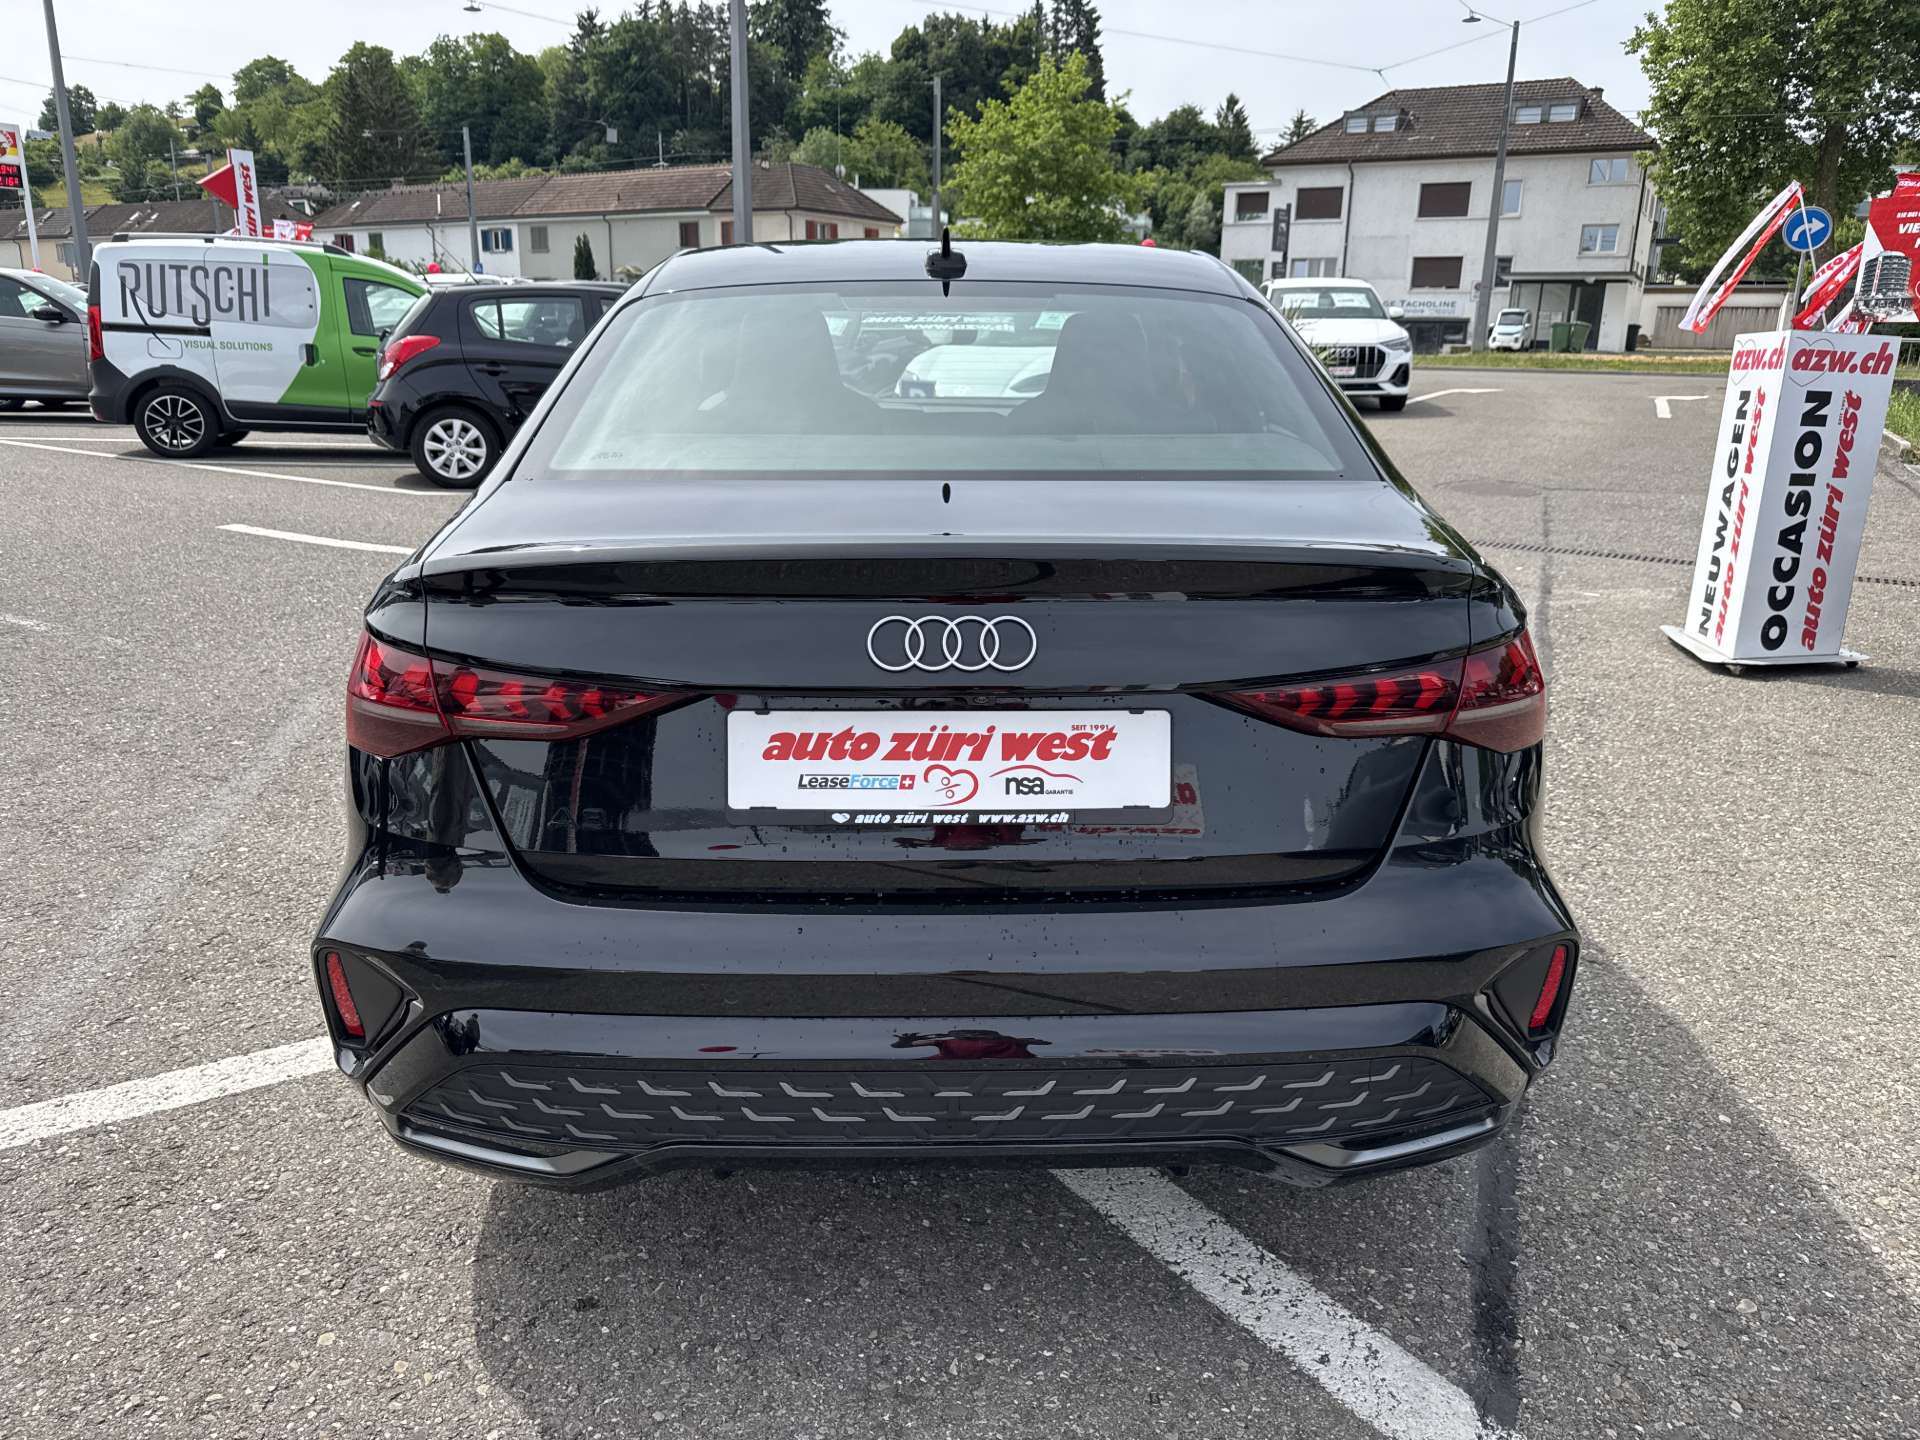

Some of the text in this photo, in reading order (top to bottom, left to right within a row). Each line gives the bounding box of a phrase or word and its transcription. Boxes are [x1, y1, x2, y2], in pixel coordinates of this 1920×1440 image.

[119, 253, 270, 327] RUTSCHI
[183, 339, 273, 352] VISUAL SOLUTIONS
[1732, 336, 1786, 372] azw.ch
[1791, 341, 1894, 375] azw.ch
[1698, 390, 1751, 637] NEUWAGEN
[1714, 385, 1766, 647] auto züri west
[1760, 390, 1832, 652] OCCASION
[1801, 389, 1863, 651] auto züri west
[762, 725, 1118, 762] auto züri west
[798, 774, 899, 789] LeaseForce
[1005, 776, 1045, 796] nsa
[854, 811, 1070, 824] auto züri west www.azw.ch
